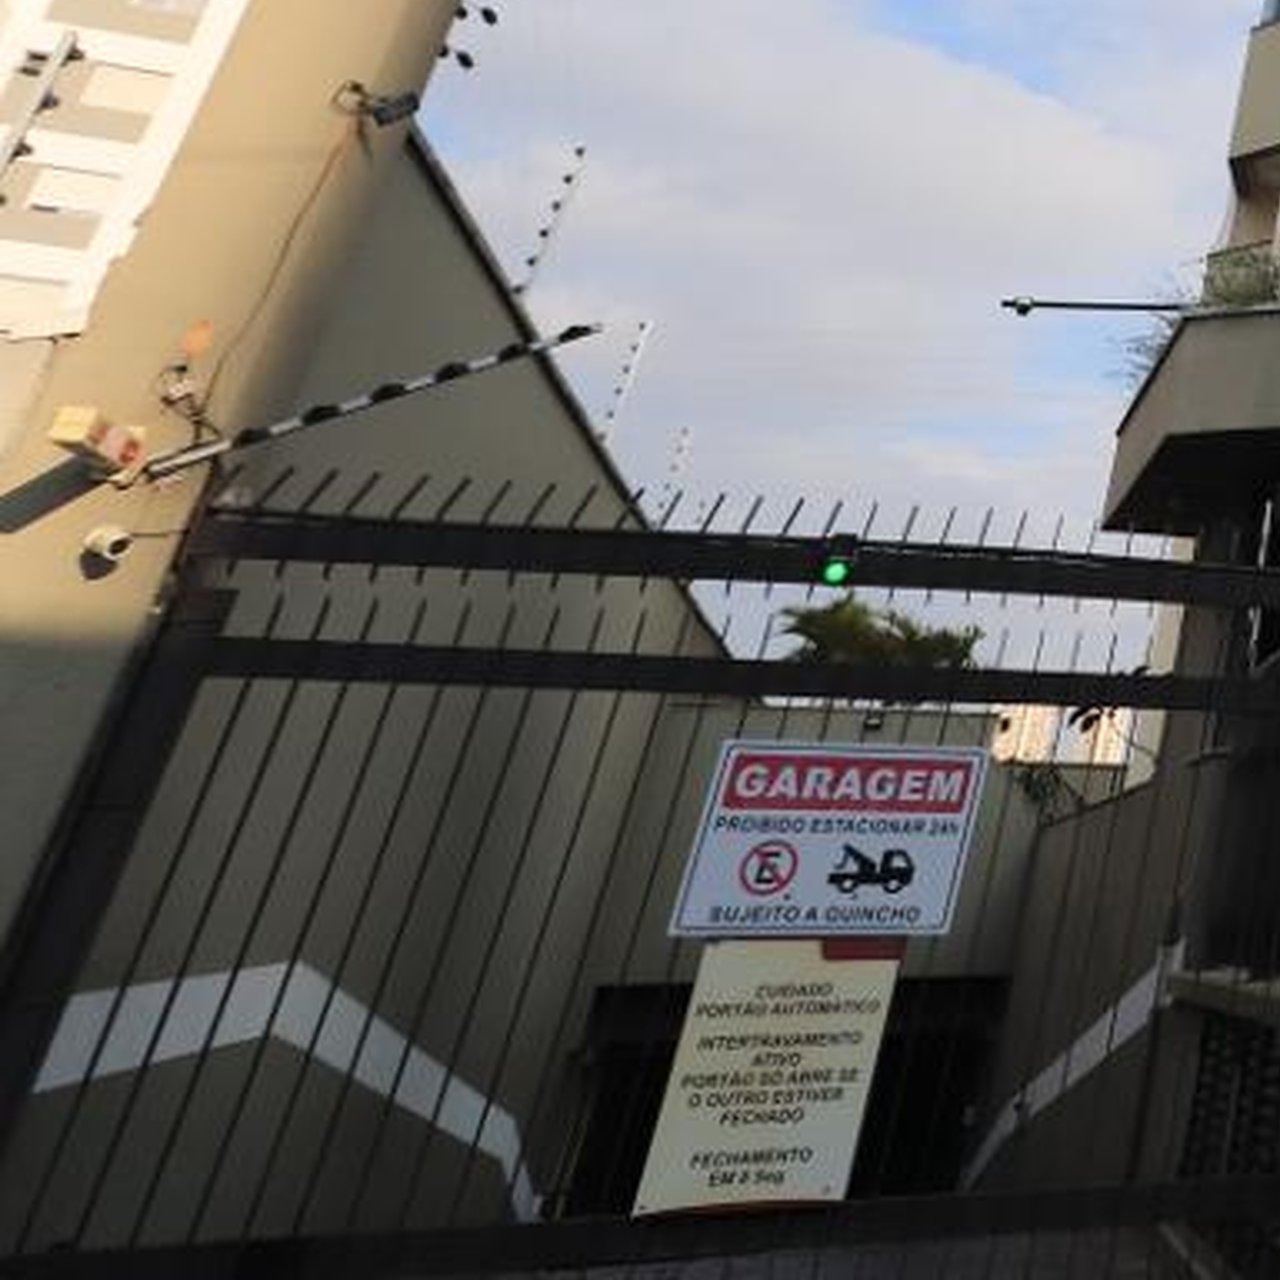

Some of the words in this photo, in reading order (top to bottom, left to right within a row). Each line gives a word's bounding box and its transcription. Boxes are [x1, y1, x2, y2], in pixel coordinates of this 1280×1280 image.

[733, 764, 966, 802] GARAGEM
[713, 816, 804, 834] PROIBIDO
[809, 816, 926, 835] ESTACIONAR
[709, 905, 800, 922] SUJEITO
[805, 906, 818, 921] A
[755, 982, 833, 998] CUIDADO
[697, 1031, 863, 1051] INTERTRAVAMENTO
[751, 1052, 801, 1067] ATIVO
[787, 1069, 831, 1085] ABRE
[688, 1092, 701, 1107] O
[706, 1089, 768, 1108] OUTRO
[773, 1087, 843, 1105] ESTIVER
[719, 1107, 804, 1126] FECHADO
[690, 1146, 814, 1169] FECHAMENTO
[708, 1171, 736, 1187] EM
